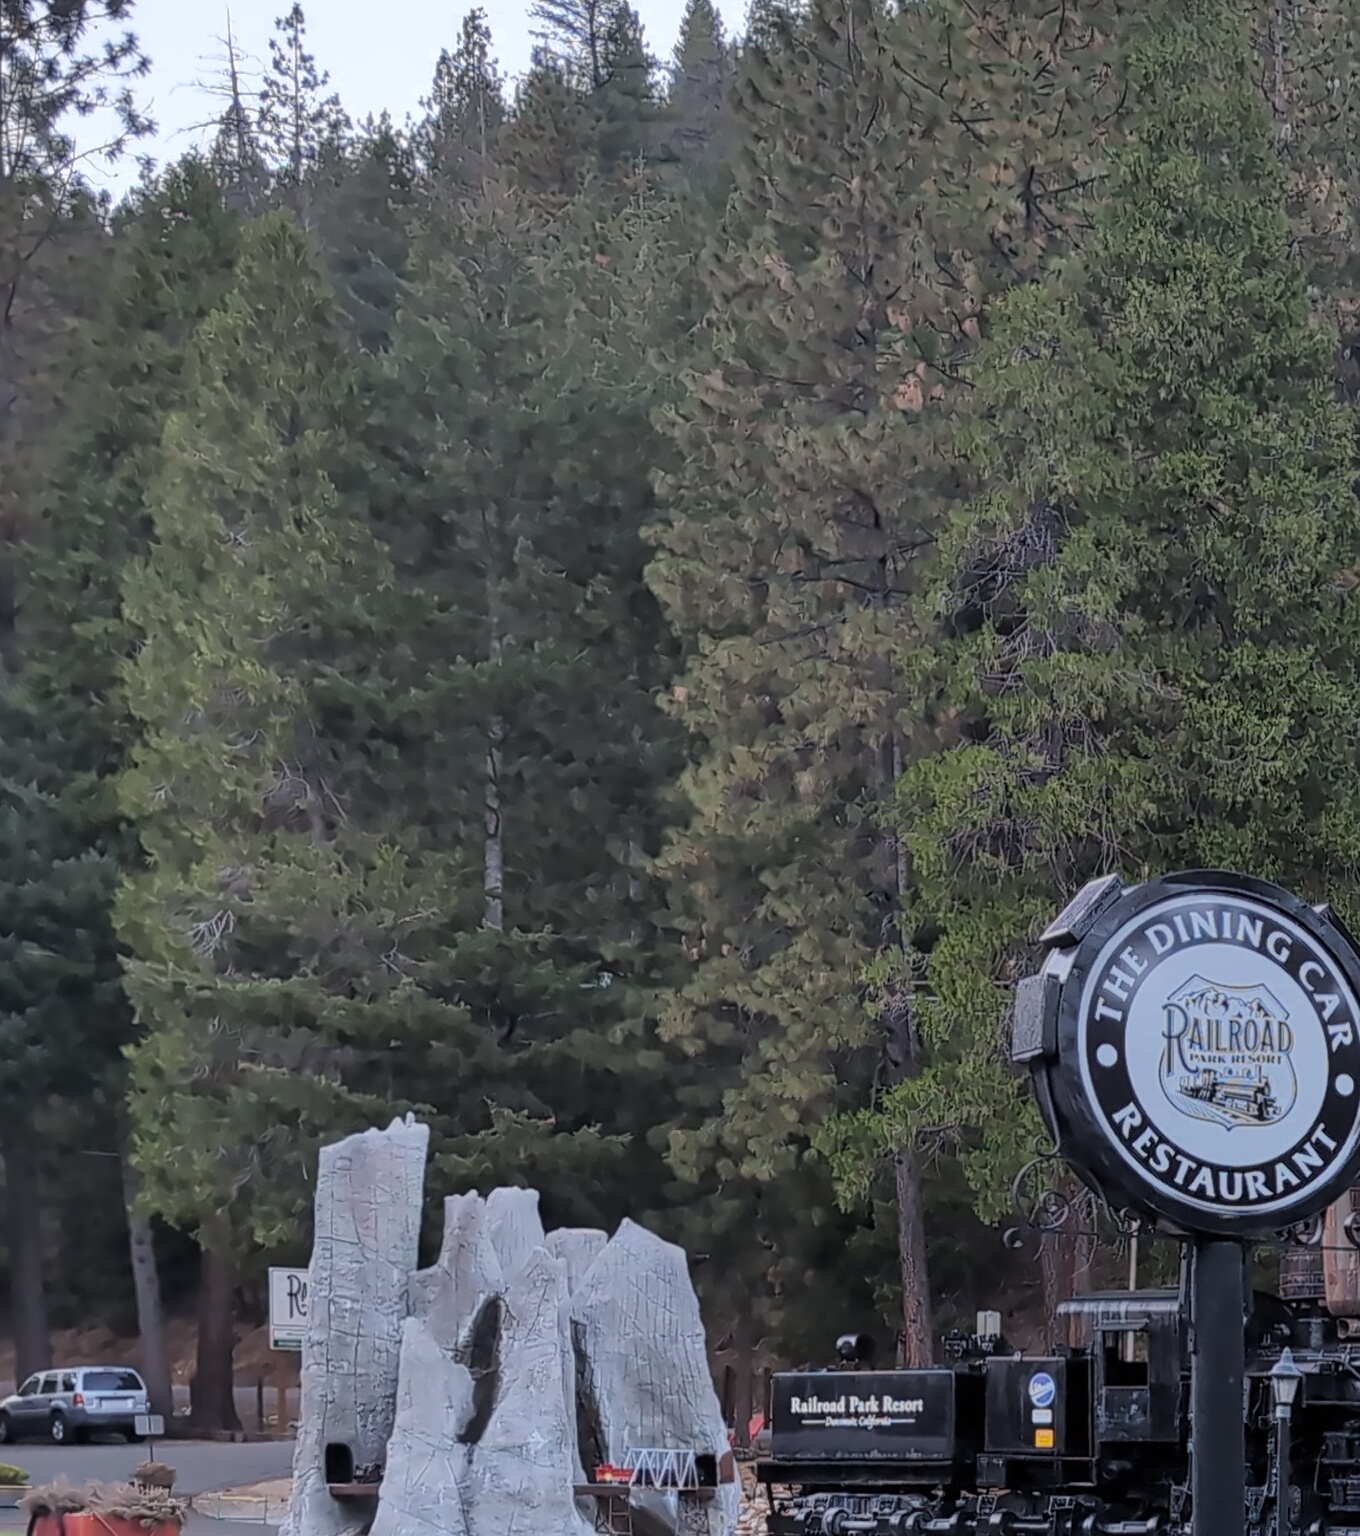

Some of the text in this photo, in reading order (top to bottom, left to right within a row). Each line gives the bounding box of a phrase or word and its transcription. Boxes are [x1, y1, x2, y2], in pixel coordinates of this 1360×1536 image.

[1095, 909, 1354, 1053] THE DINING CAR
[1161, 1003, 1294, 1077] RAILROAD
[1190, 1053, 1282, 1065] PARK RESORT
[1112, 1101, 1337, 1200] RESTAURANT
[791, 1394, 923, 1413] Railroad Park Resort
